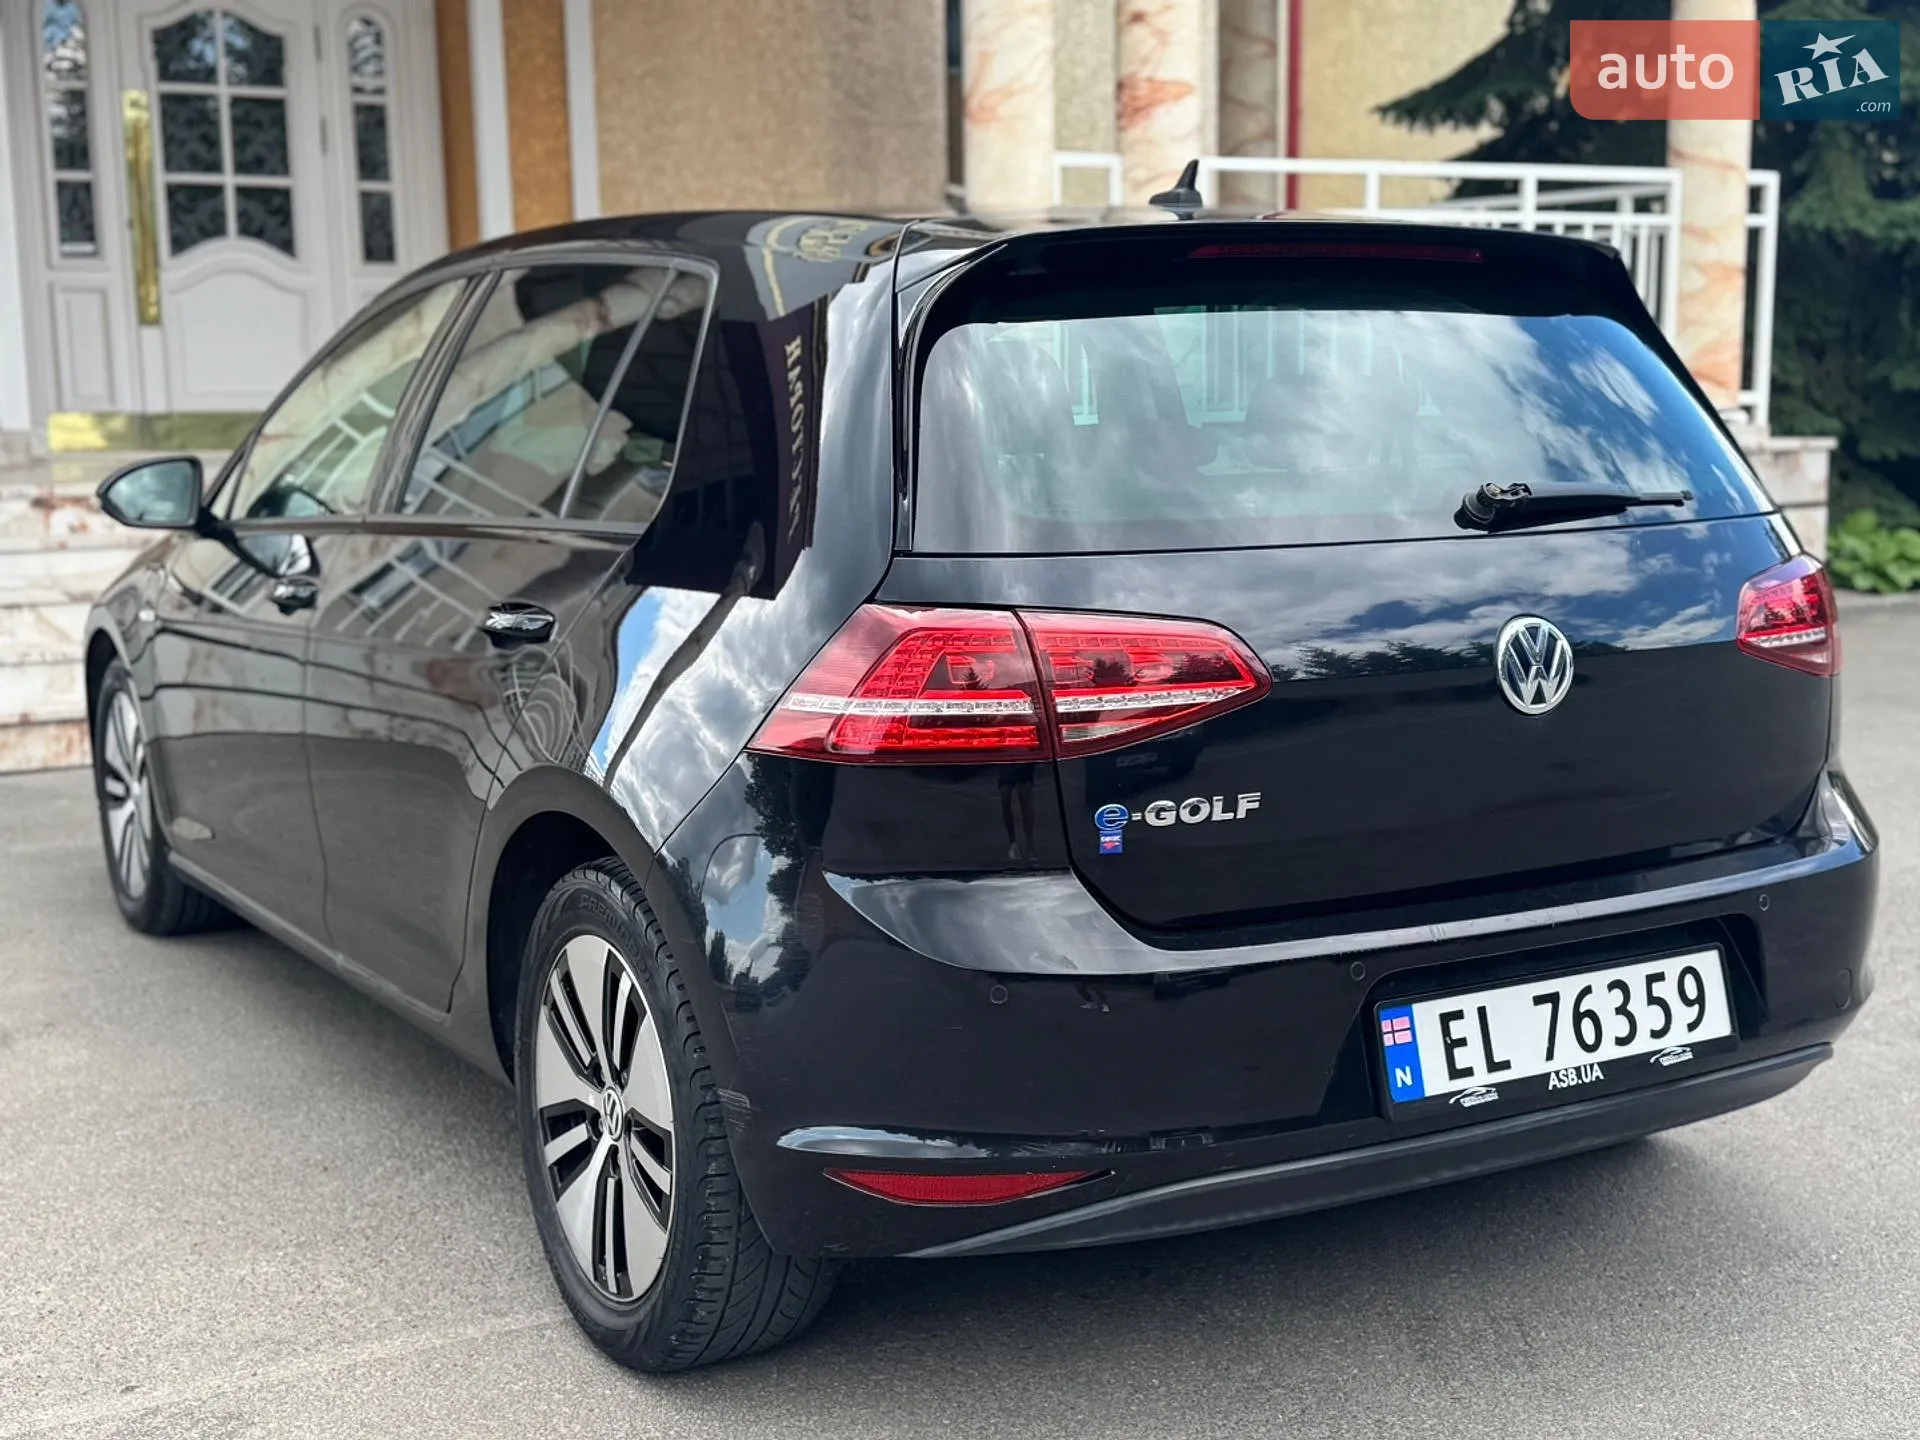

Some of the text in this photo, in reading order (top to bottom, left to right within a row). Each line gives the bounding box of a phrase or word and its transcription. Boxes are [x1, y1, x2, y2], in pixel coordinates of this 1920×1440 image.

[1094, 792, 1261, 831] e-GOLF
[1439, 965, 1706, 1081] EL 76359
[1395, 1067, 1413, 1089] N
[1548, 1062, 1605, 1090] ASB.UA
